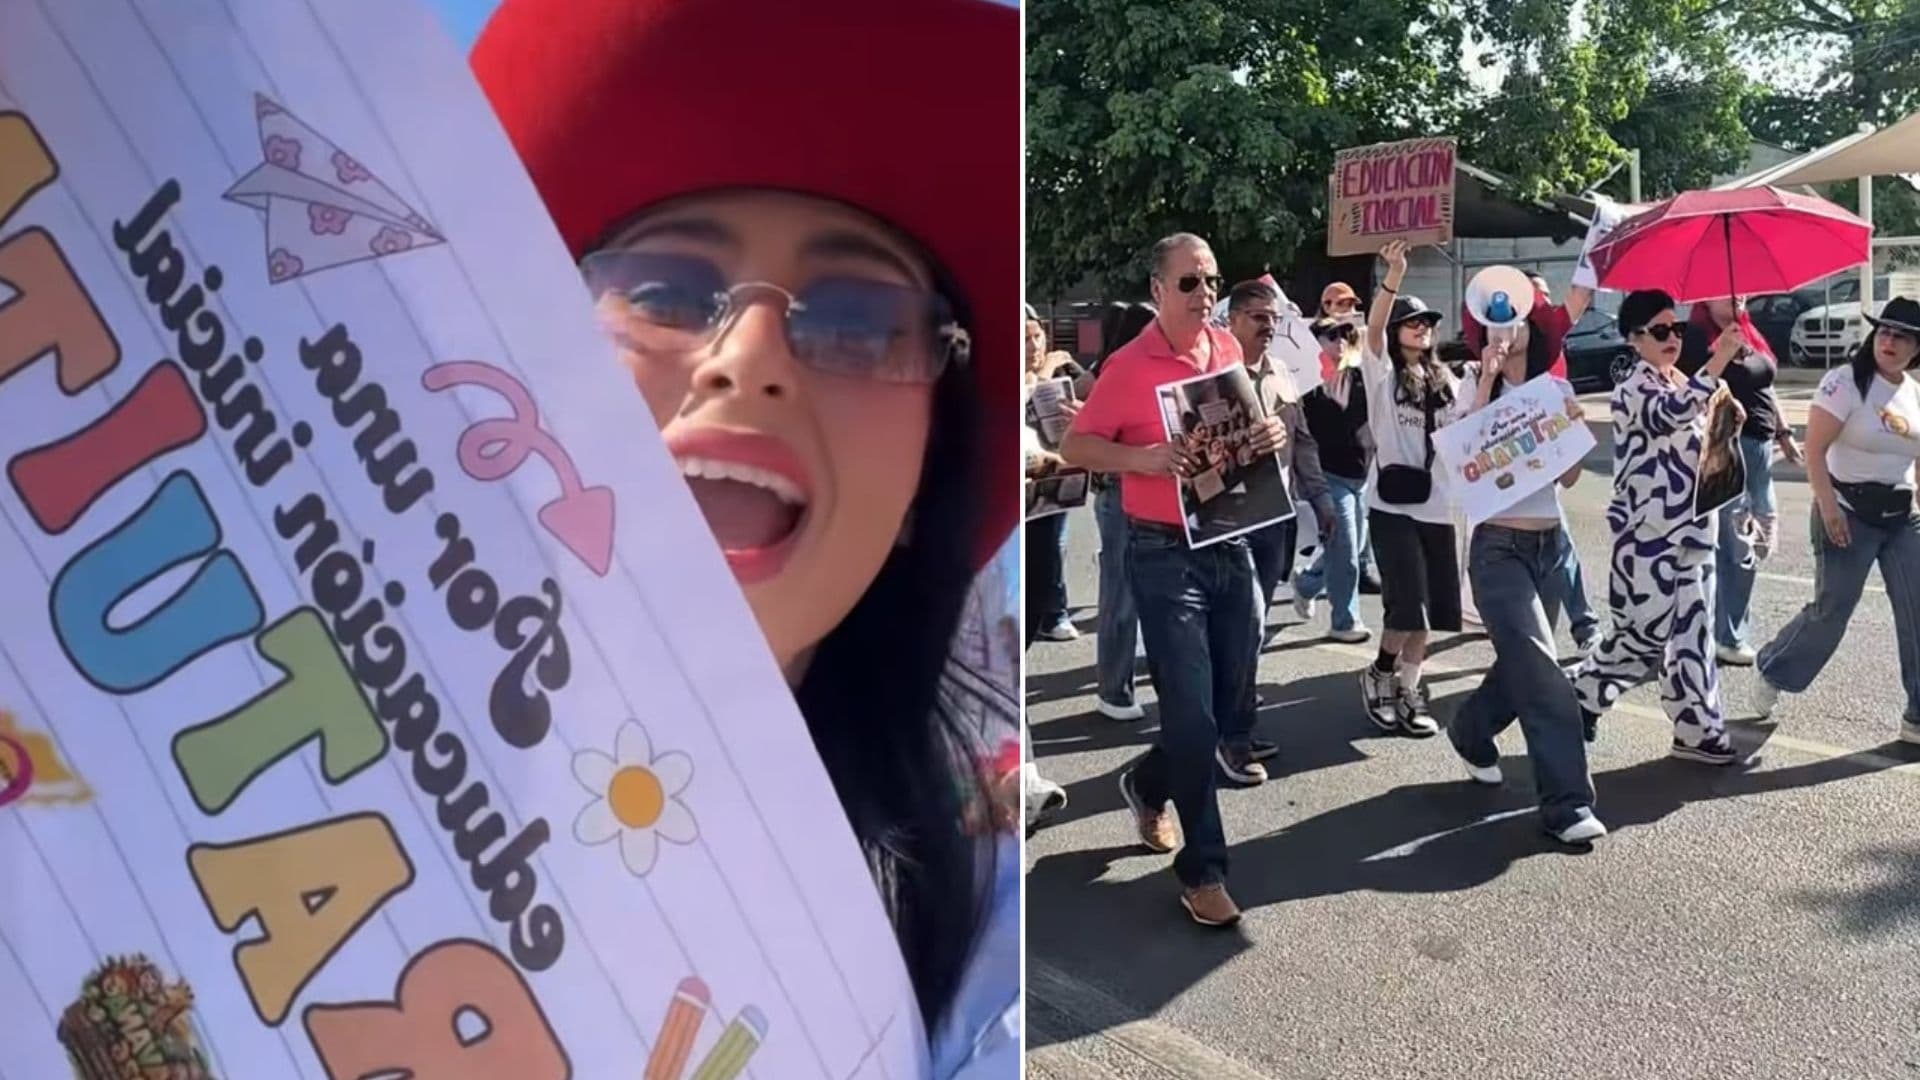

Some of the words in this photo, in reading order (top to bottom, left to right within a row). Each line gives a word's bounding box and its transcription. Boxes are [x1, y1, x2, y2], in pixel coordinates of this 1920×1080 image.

[1342, 149, 1453, 198] EDUCACION
[1361, 194, 1442, 233] INICIAL
[1463, 414, 1570, 483] GRATUITA
